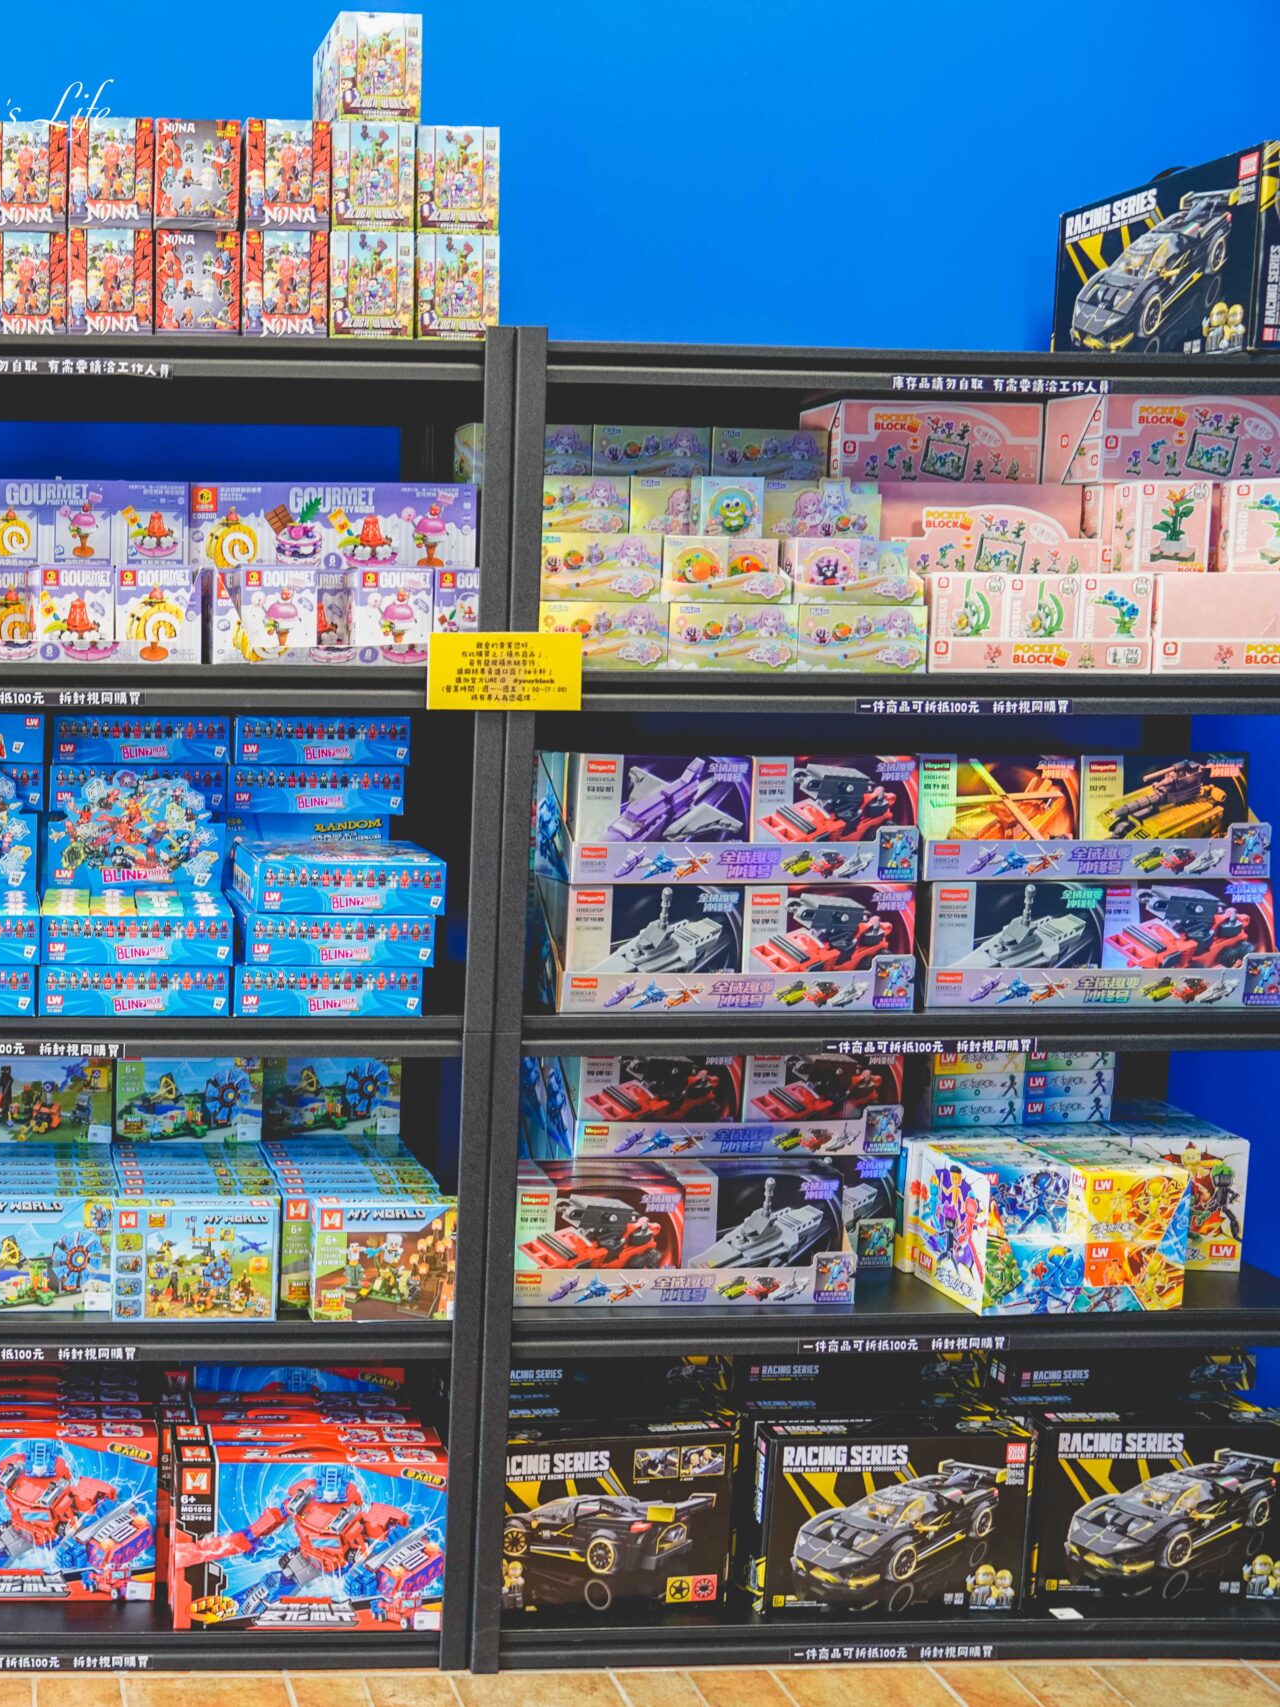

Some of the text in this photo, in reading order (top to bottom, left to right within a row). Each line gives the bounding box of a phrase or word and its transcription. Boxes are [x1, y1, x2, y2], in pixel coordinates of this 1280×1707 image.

[1065, 188, 1157, 239] RACING SERIES
[48, 360, 170, 378] 有需要請洽工作人員
[892, 376, 1109, 394] 庫存品請勿自取 有需要請洽工作人員
[1139, 406, 1181, 415] POCKET
[874, 413, 916, 422] POCKET
[1138, 415, 1173, 425] BLOCK
[874, 422, 907, 432] BLOCK
[6, 484, 88, 506] GOURMET
[289, 487, 375, 513] GOURMET
[925, 511, 968, 520] POCKET
[925, 520, 960, 529] BLOCK
[60, 570, 110, 586] GOURMET
[1012, 643, 1063, 654] POCKET
[1012, 654, 1052, 665] BLOCK
[59, 691, 141, 705] 拆封視同購買
[860, 699, 1069, 714] 一件商品可折抵100元 拆封視同購買
[47, 996, 63, 1004] LW
[39, 1043, 120, 1057] 拆封視同購買
[827, 1039, 1032, 1053] 一件商品可折抵100元 拆封視同購買
[1094, 1181, 1112, 1191] LW
[203, 1214, 268, 1224] MY WORLD
[347, 1208, 426, 1220] MY WORLD
[1211, 1246, 1233, 1257] LW
[803, 1338, 1005, 1352] 一件商品可折抵100元 拆封視同購買
[58, 1347, 136, 1360] 拆封視同購買
[761, 1364, 819, 1375] RACING SERIES
[1058, 1433, 1184, 1452] RACING SERIES
[783, 1445, 909, 1466] RACING SERIES
[506, 1451, 610, 1476] ACING SERIES
[181, 1495, 196, 1503] 6+
[794, 1646, 993, 1659] 一件商品可折抵100元 拆封視同購買
[73, 1656, 149, 1668] 拆封視同購買
